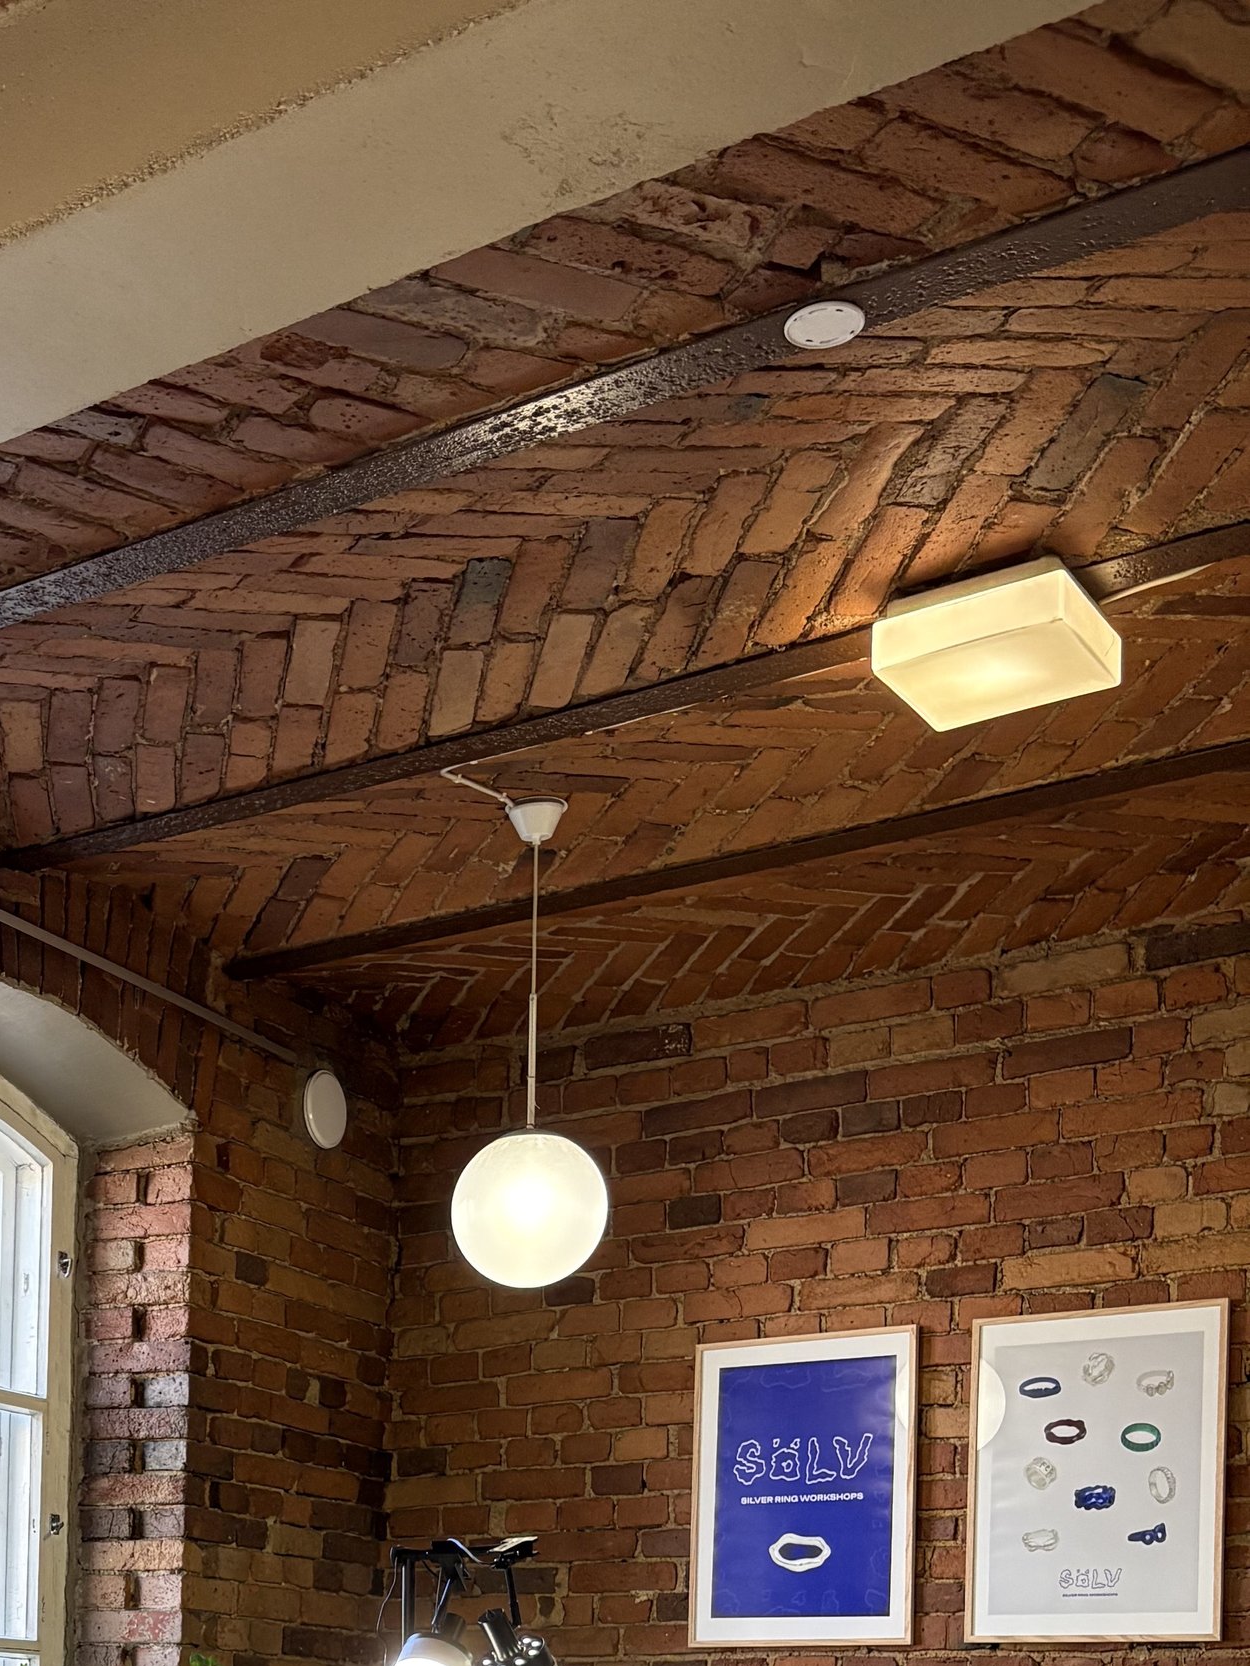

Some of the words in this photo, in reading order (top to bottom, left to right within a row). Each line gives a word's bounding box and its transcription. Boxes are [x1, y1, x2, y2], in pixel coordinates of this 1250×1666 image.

[741, 1496, 773, 1504] SILVER
[775, 1495, 798, 1503] RING
[800, 1492, 863, 1502] WORKSHOPS
